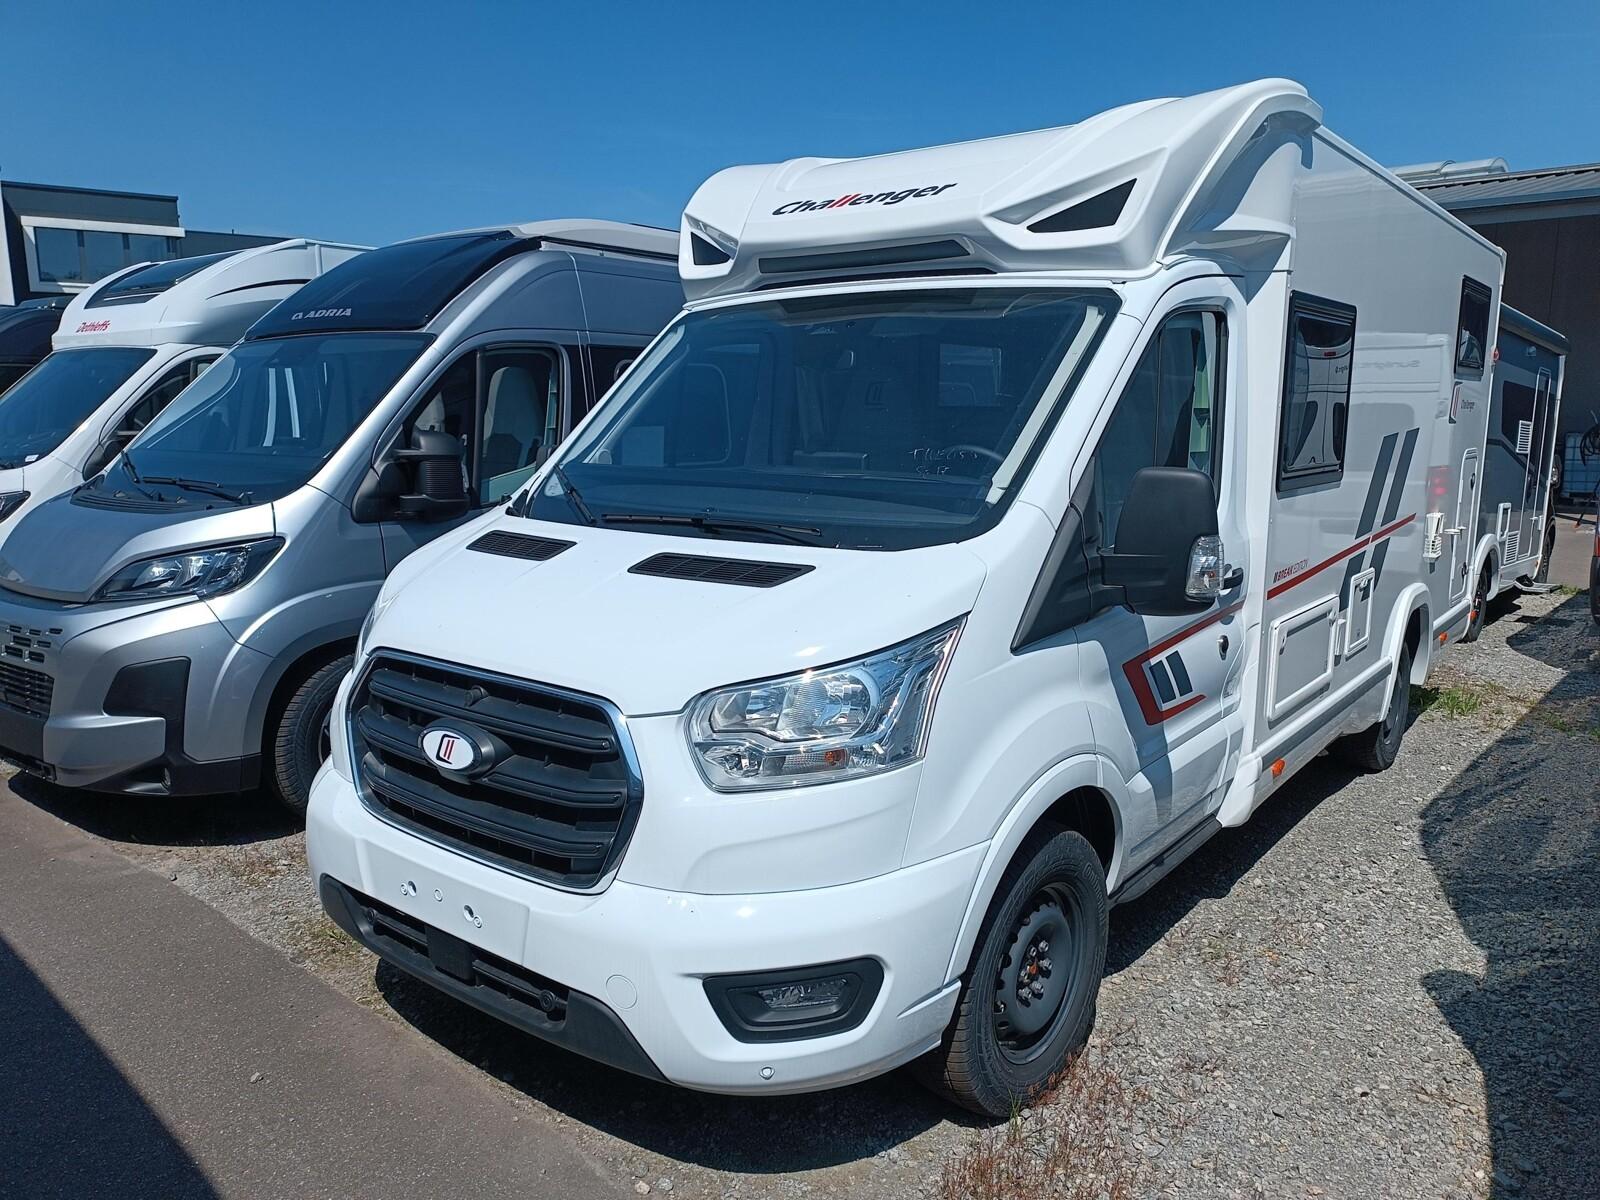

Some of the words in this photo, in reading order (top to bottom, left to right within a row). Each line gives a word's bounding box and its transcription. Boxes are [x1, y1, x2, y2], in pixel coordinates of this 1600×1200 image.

[772, 183, 957, 215] Challenger
[304, 308, 352, 319] ADRIA
[75, 319, 111, 333] Dethleffs
